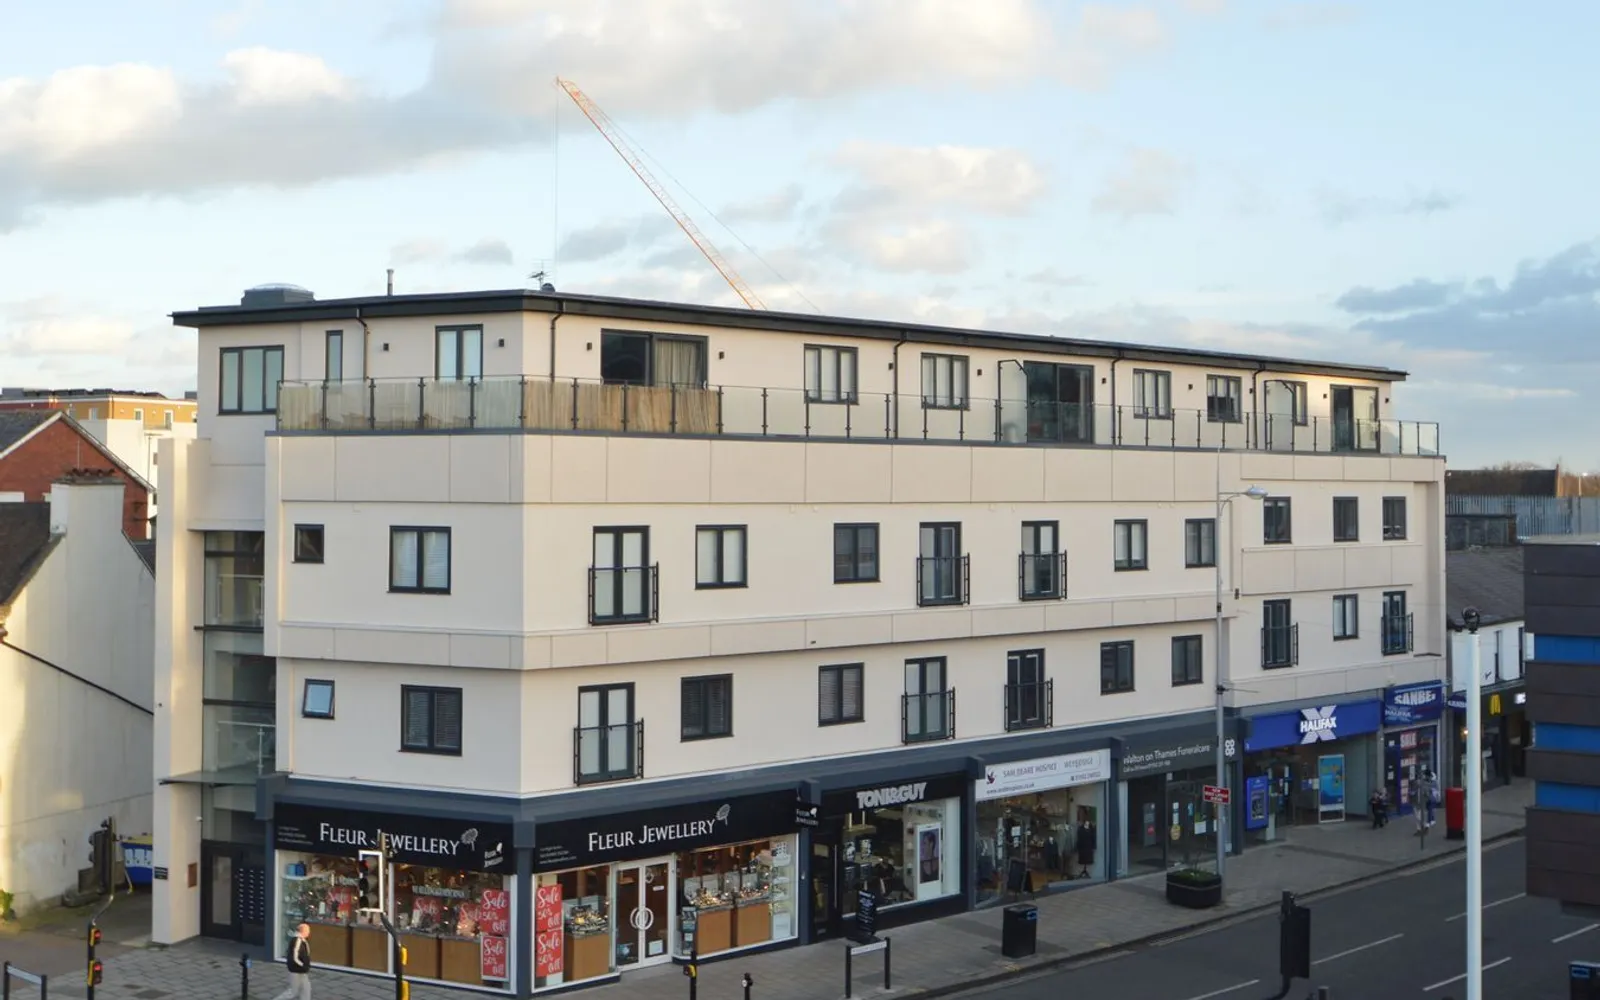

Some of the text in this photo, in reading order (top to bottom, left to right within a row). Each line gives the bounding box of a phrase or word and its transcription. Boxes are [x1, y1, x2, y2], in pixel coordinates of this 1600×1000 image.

[1300, 717, 1337, 733] HALIFAX
[1145, 753, 1154, 761] on
[1154, 749, 1177, 759] Thames
[1177, 744, 1211, 756] Funeralcare
[856, 782, 927, 809] TONI&GUY
[320, 822, 367, 846] FLEUR
[588, 818, 716, 852] FLEUR JEWELLERY
[482, 889, 507, 909] Sale
[537, 886, 560, 908] Sale
[484, 938, 504, 956] Sale
[537, 932, 560, 954] Sale
